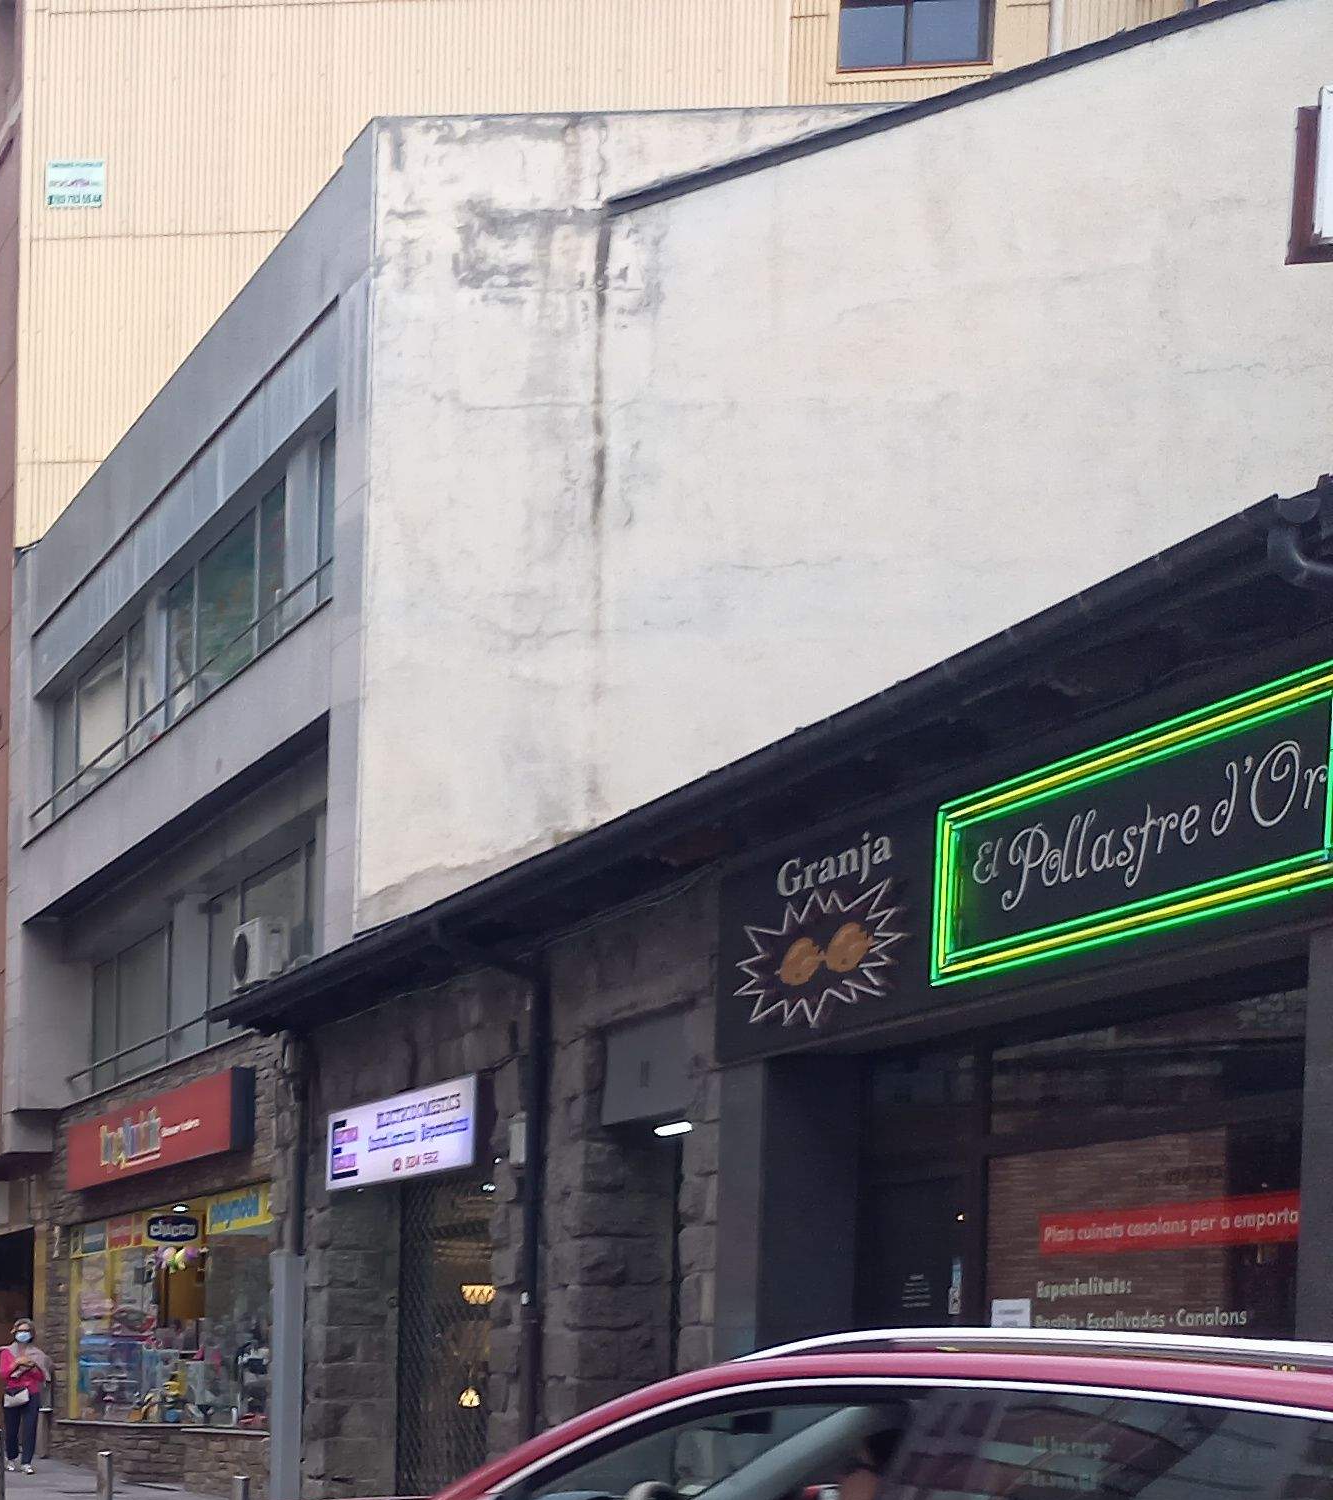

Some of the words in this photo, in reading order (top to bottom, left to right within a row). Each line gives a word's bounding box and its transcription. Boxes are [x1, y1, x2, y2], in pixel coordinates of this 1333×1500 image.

[972, 837, 1001, 885] El
[1001, 803, 1200, 912] Pollastre
[1210, 740, 1328, 835] d'Or
[777, 832, 892, 898] Granja
[1191, 1217, 1216, 1237] per
[1220, 1216, 1231, 1230] a
[1176, 1306, 1247, 1326] Canalons
